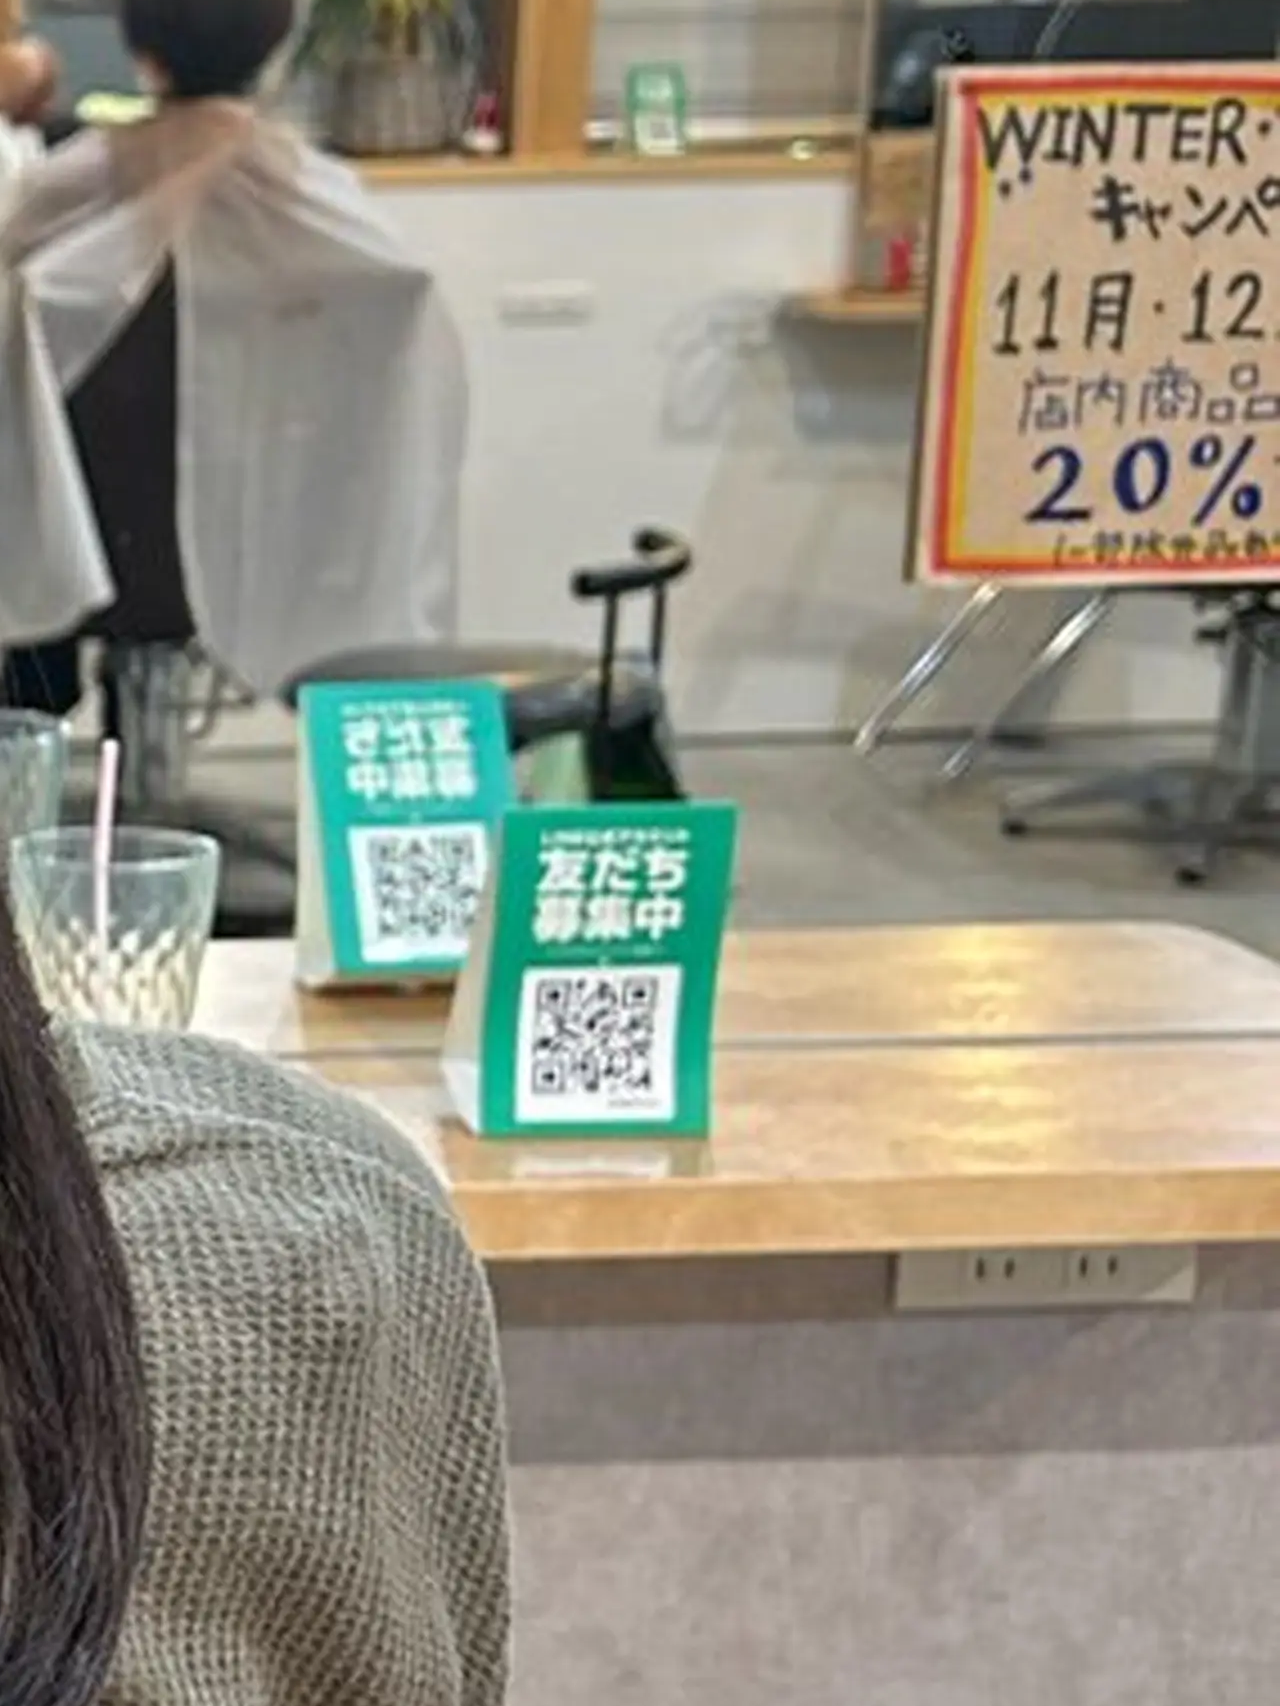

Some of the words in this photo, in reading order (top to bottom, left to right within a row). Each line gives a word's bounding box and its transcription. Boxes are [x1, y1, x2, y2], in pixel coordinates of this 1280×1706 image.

[977, 98, 1280, 170] WINTER・
[992, 268, 1280, 357] 11月・12
[1025, 433, 1264, 527] 20%
[536, 845, 691, 893] 友だち
